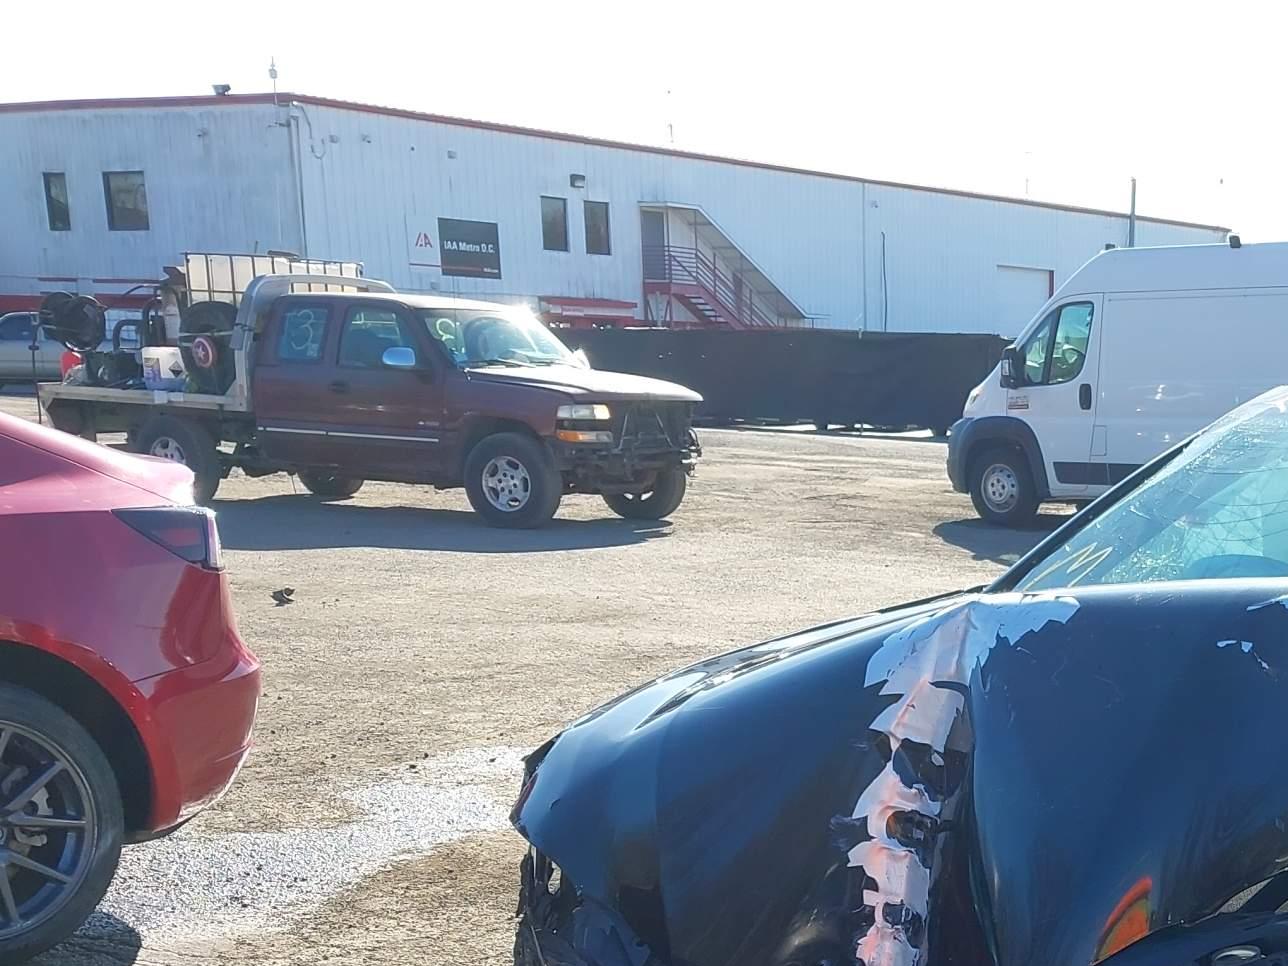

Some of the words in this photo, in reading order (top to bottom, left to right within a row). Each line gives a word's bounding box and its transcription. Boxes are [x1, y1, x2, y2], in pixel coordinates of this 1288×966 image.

[444, 240, 458, 250] IAA
[459, 241, 480, 252] Metro
[481, 243, 495, 253] D.C.
